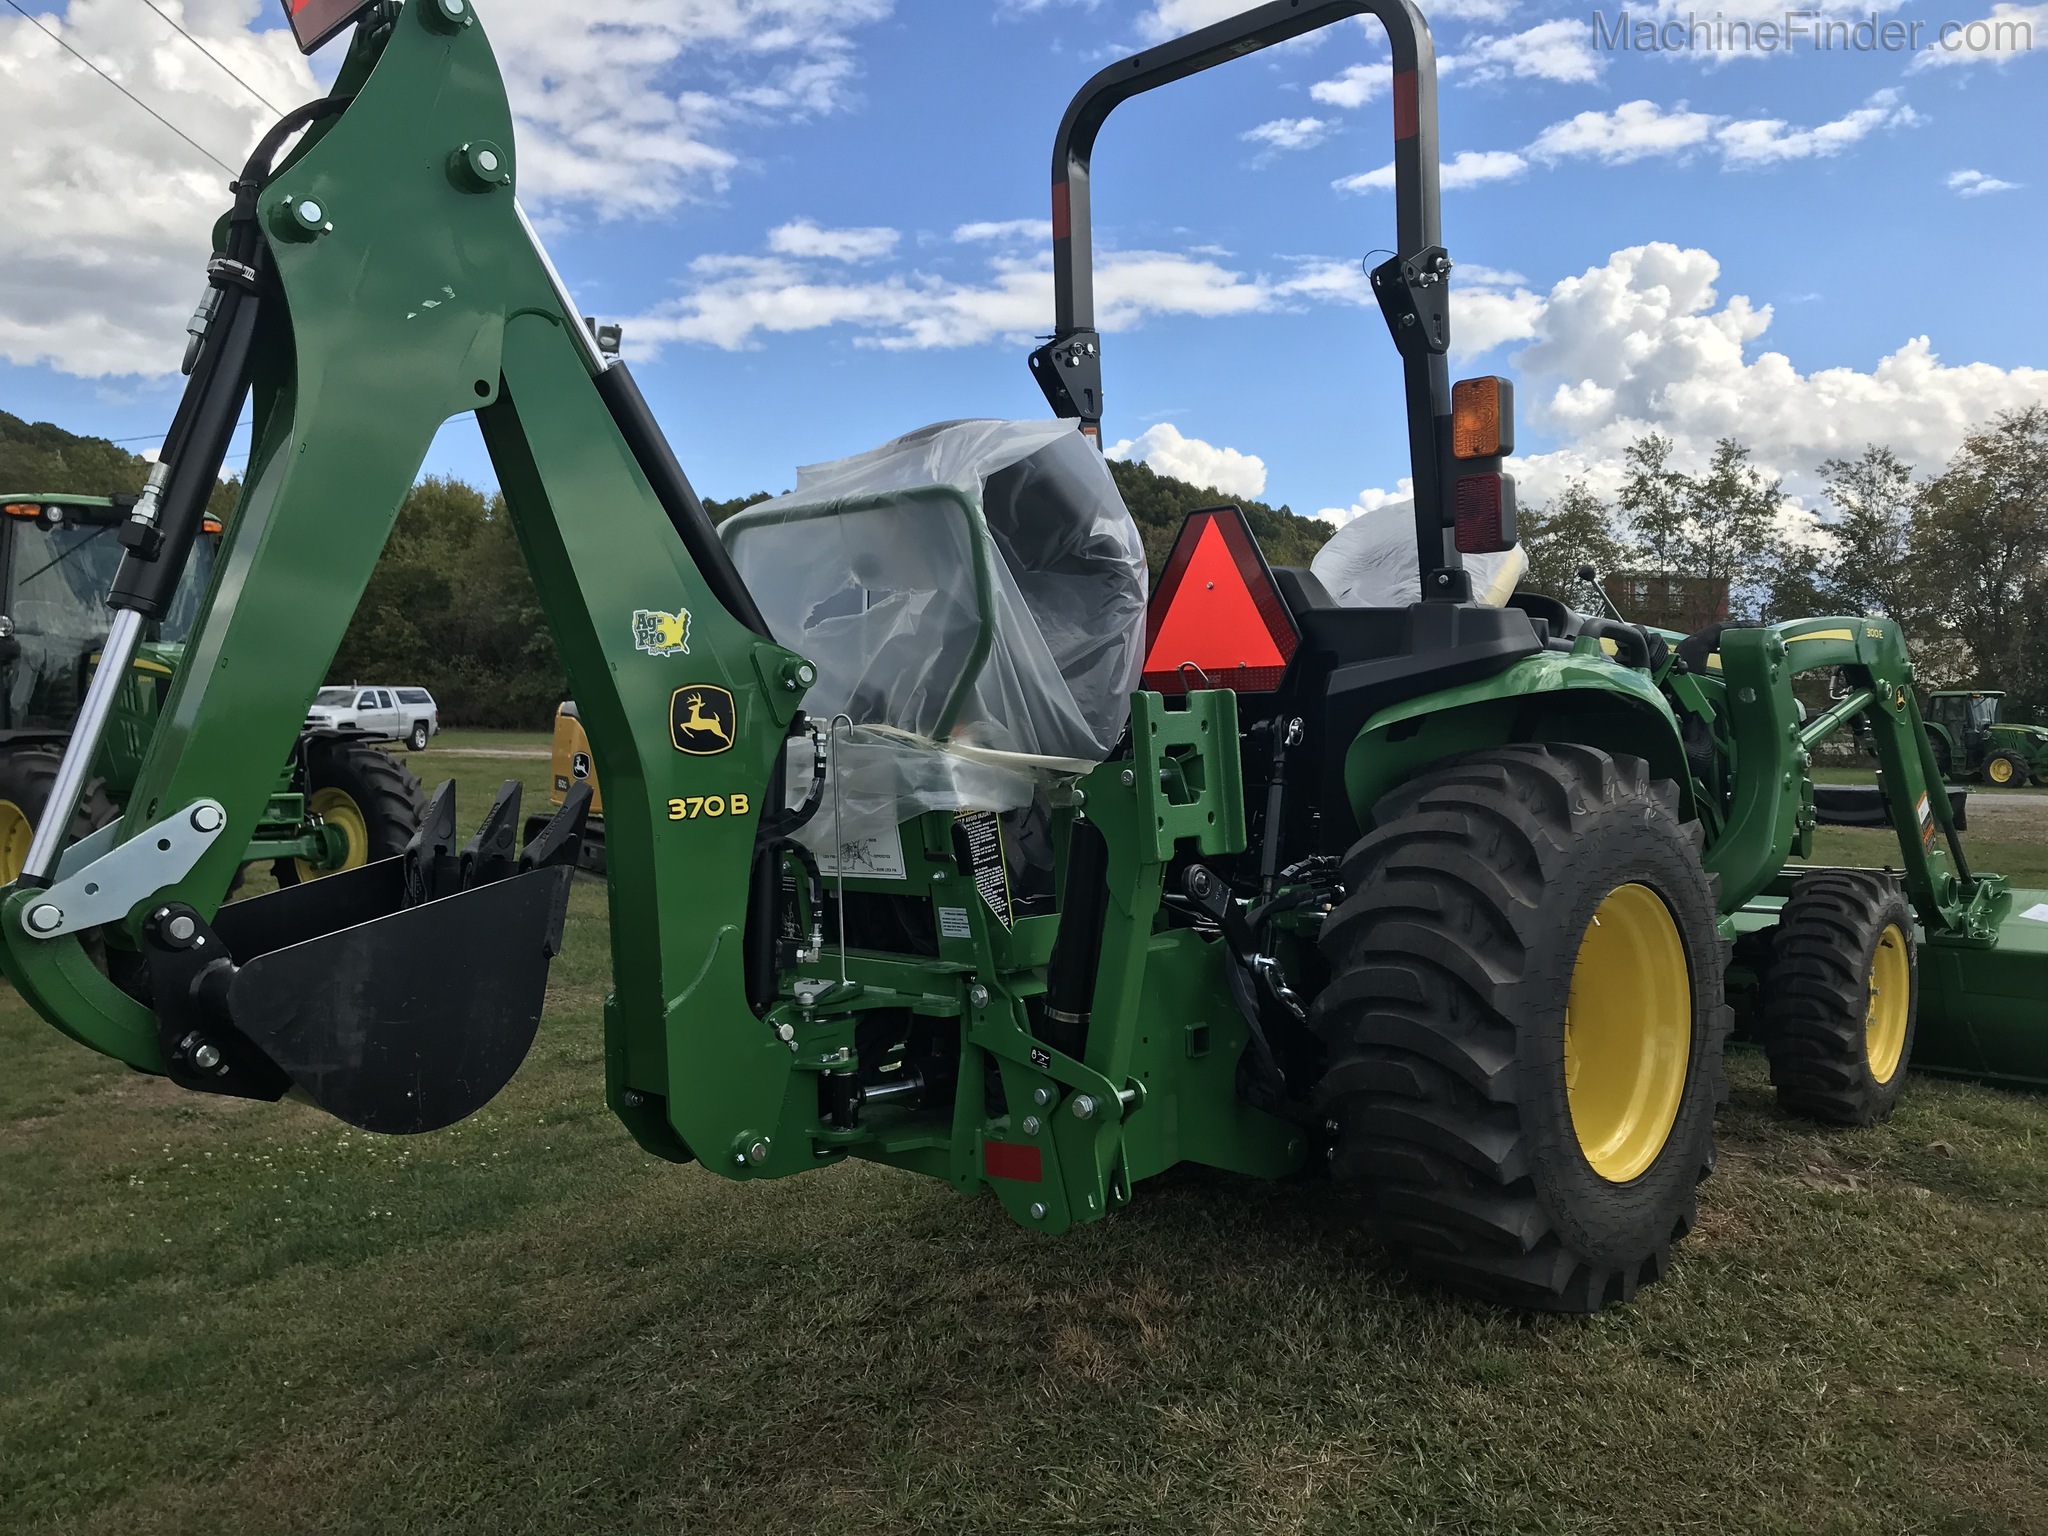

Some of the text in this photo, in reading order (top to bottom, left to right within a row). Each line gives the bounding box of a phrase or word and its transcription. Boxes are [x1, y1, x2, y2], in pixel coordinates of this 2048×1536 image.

[636, 613, 663, 633] Ag-
[637, 629, 666, 647] Pro
[1866, 627, 1884, 639] 300E
[667, 793, 751, 821] 370 B
